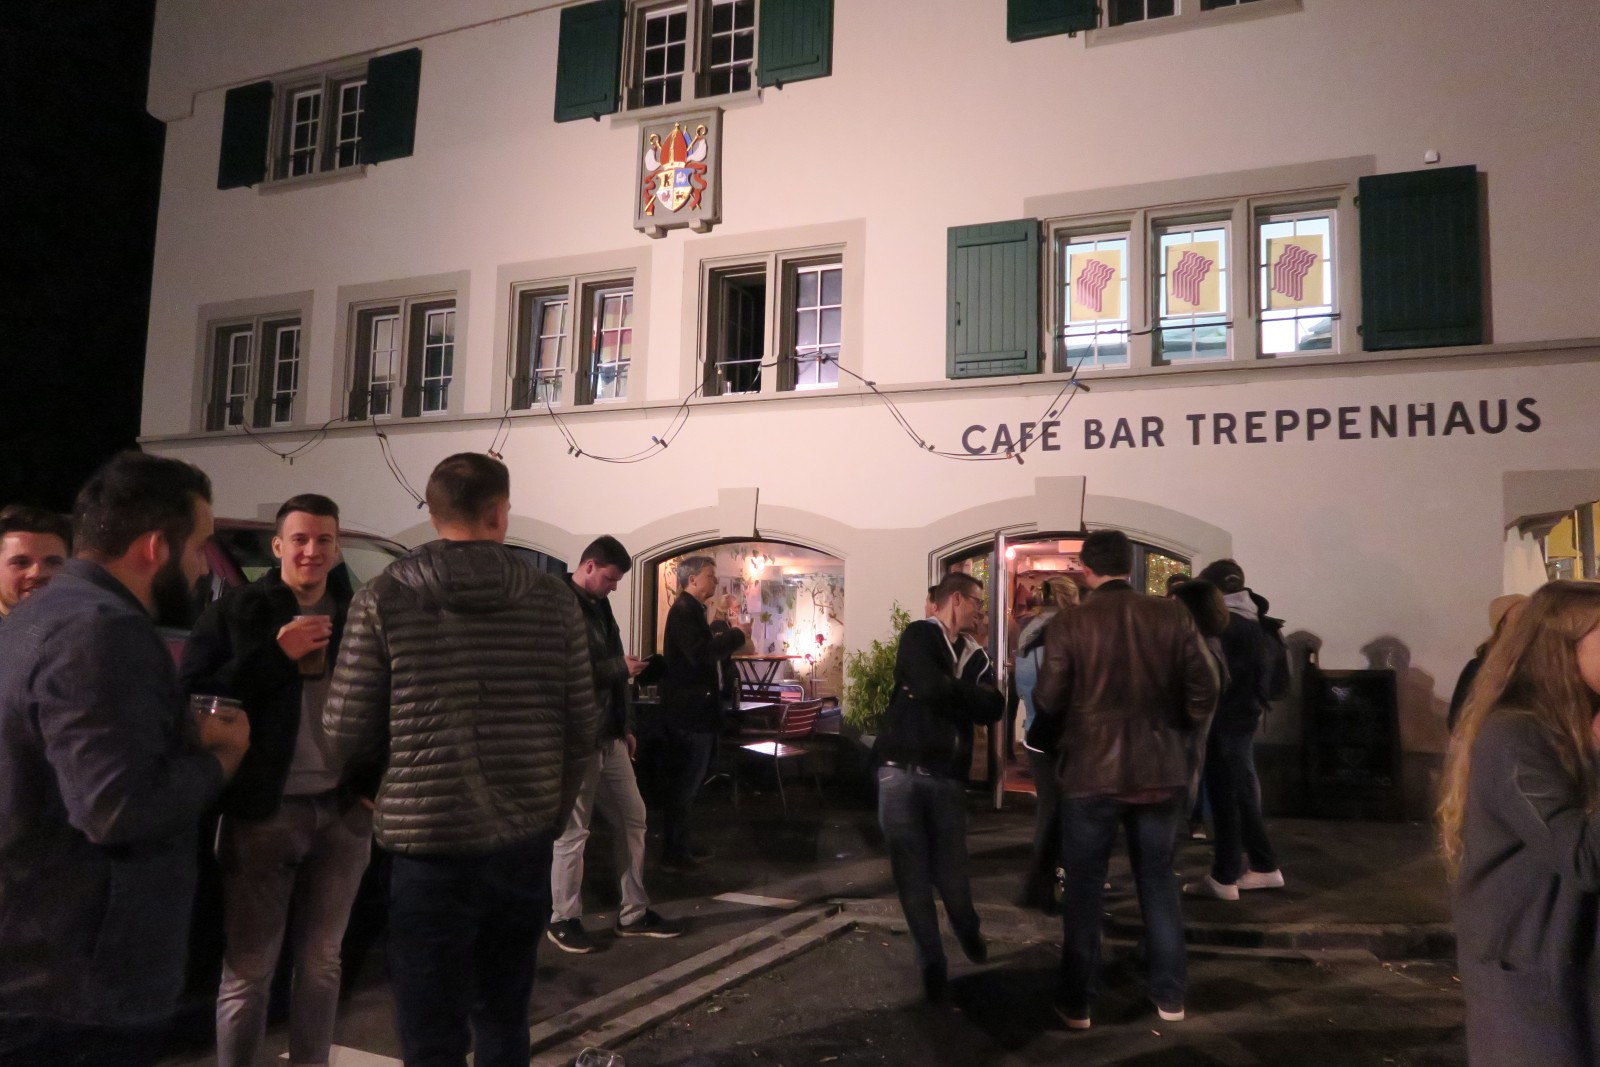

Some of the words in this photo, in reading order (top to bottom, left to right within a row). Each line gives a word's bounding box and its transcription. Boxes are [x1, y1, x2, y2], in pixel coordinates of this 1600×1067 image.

[962, 409, 1061, 455] CAFÉ
[1084, 416, 1165, 450] BAR
[1186, 397, 1541, 445] TREPPENHAUS
